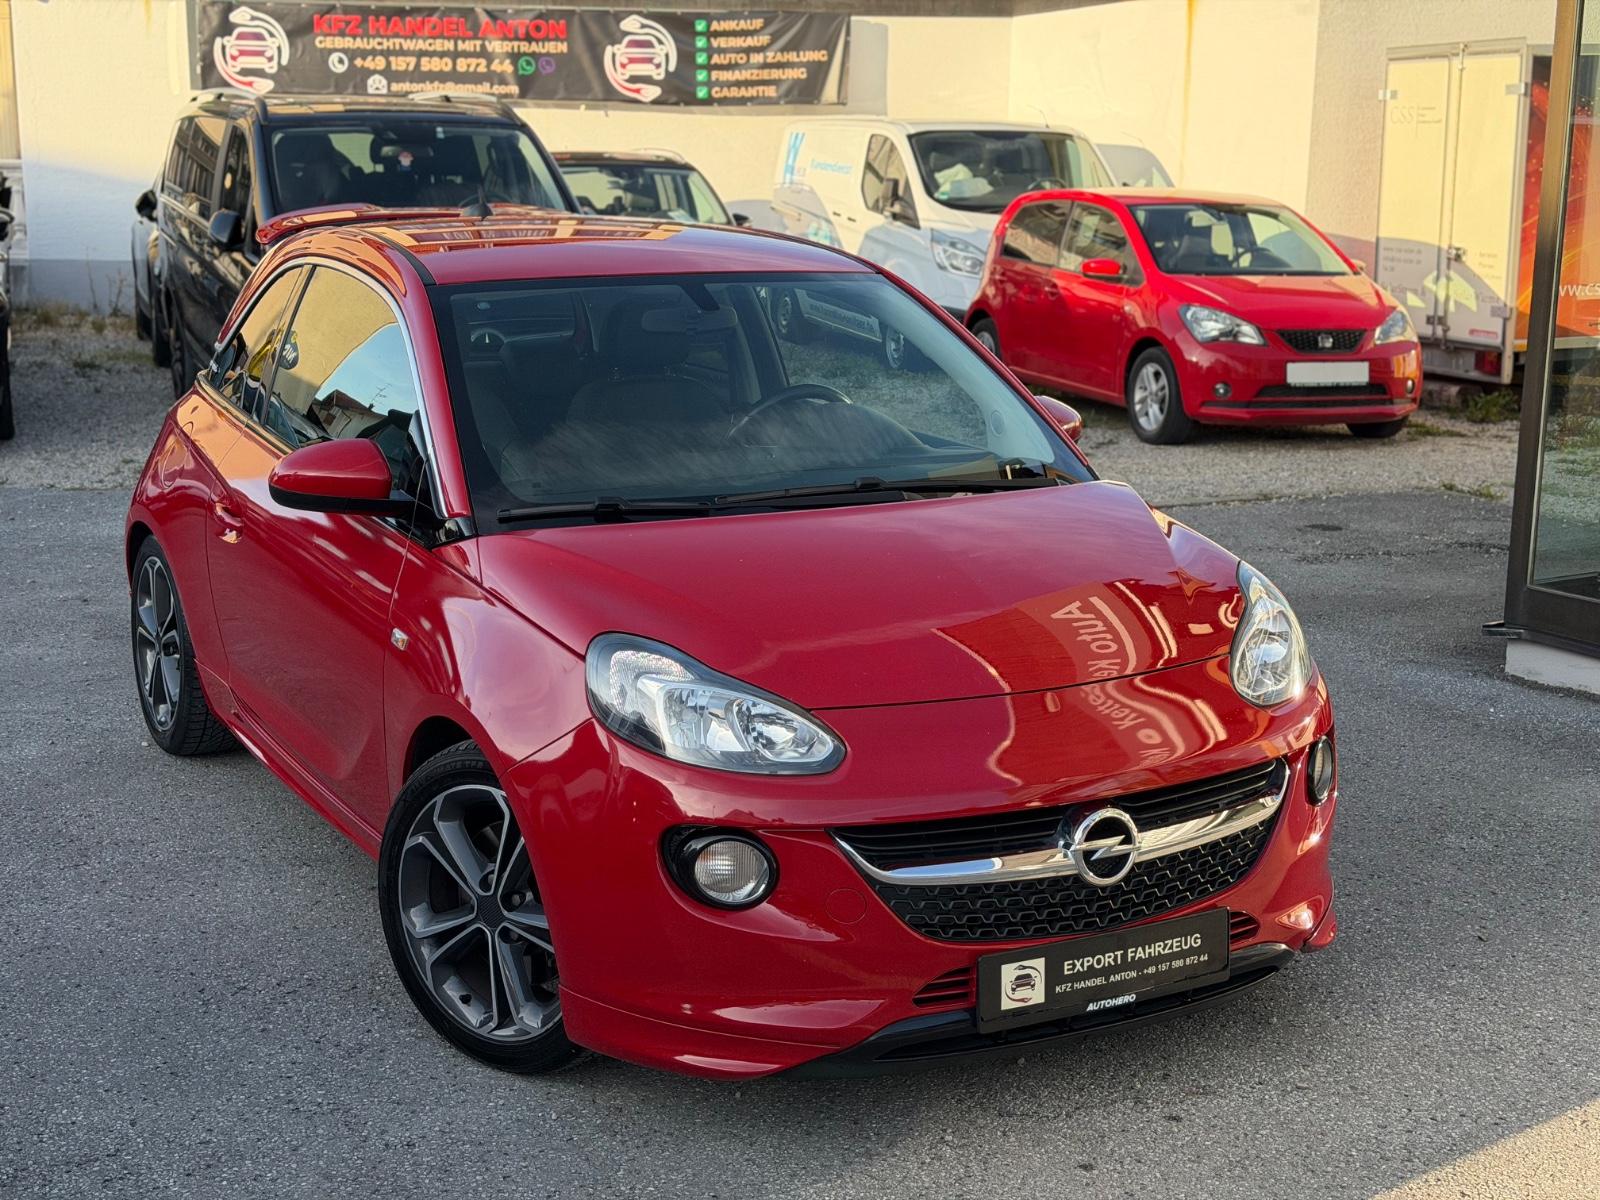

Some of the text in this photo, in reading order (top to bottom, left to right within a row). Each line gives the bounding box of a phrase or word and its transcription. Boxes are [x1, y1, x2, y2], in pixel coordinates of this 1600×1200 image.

[313, 14, 567, 40] KFZ HANDEL ANTON
[710, 18, 764, 32] ANKAUF
[315, 36, 568, 54] GEBRAUCHTWAGEN MIT VERTRAUEN
[710, 35, 771, 48] VERKAUF
[353, 55, 514, 74] +49 157 580 872 44
[710, 49, 828, 65] AUTO IN ZAHLUNG
[710, 67, 807, 81] FINANZIERUNG
[390, 81, 519, 95] antonkfz@gmail.com
[711, 85, 777, 99] GARANTIE
[1063, 933, 1202, 975] EXPORT FAHRZEUG
[1055, 983, 1072, 994] KFZ
[1073, 976, 1107, 990] HANDEL
[1109, 970, 1137, 983] ANTON
[1143, 965, 1156, 975] +49
[1158, 961, 1170, 972] 157
[1171, 958, 1184, 968] 580
[1185, 956, 1198, 965] 872
[1199, 953, 1209, 962] 44
[1086, 993, 1137, 1012] AUTOHERO
